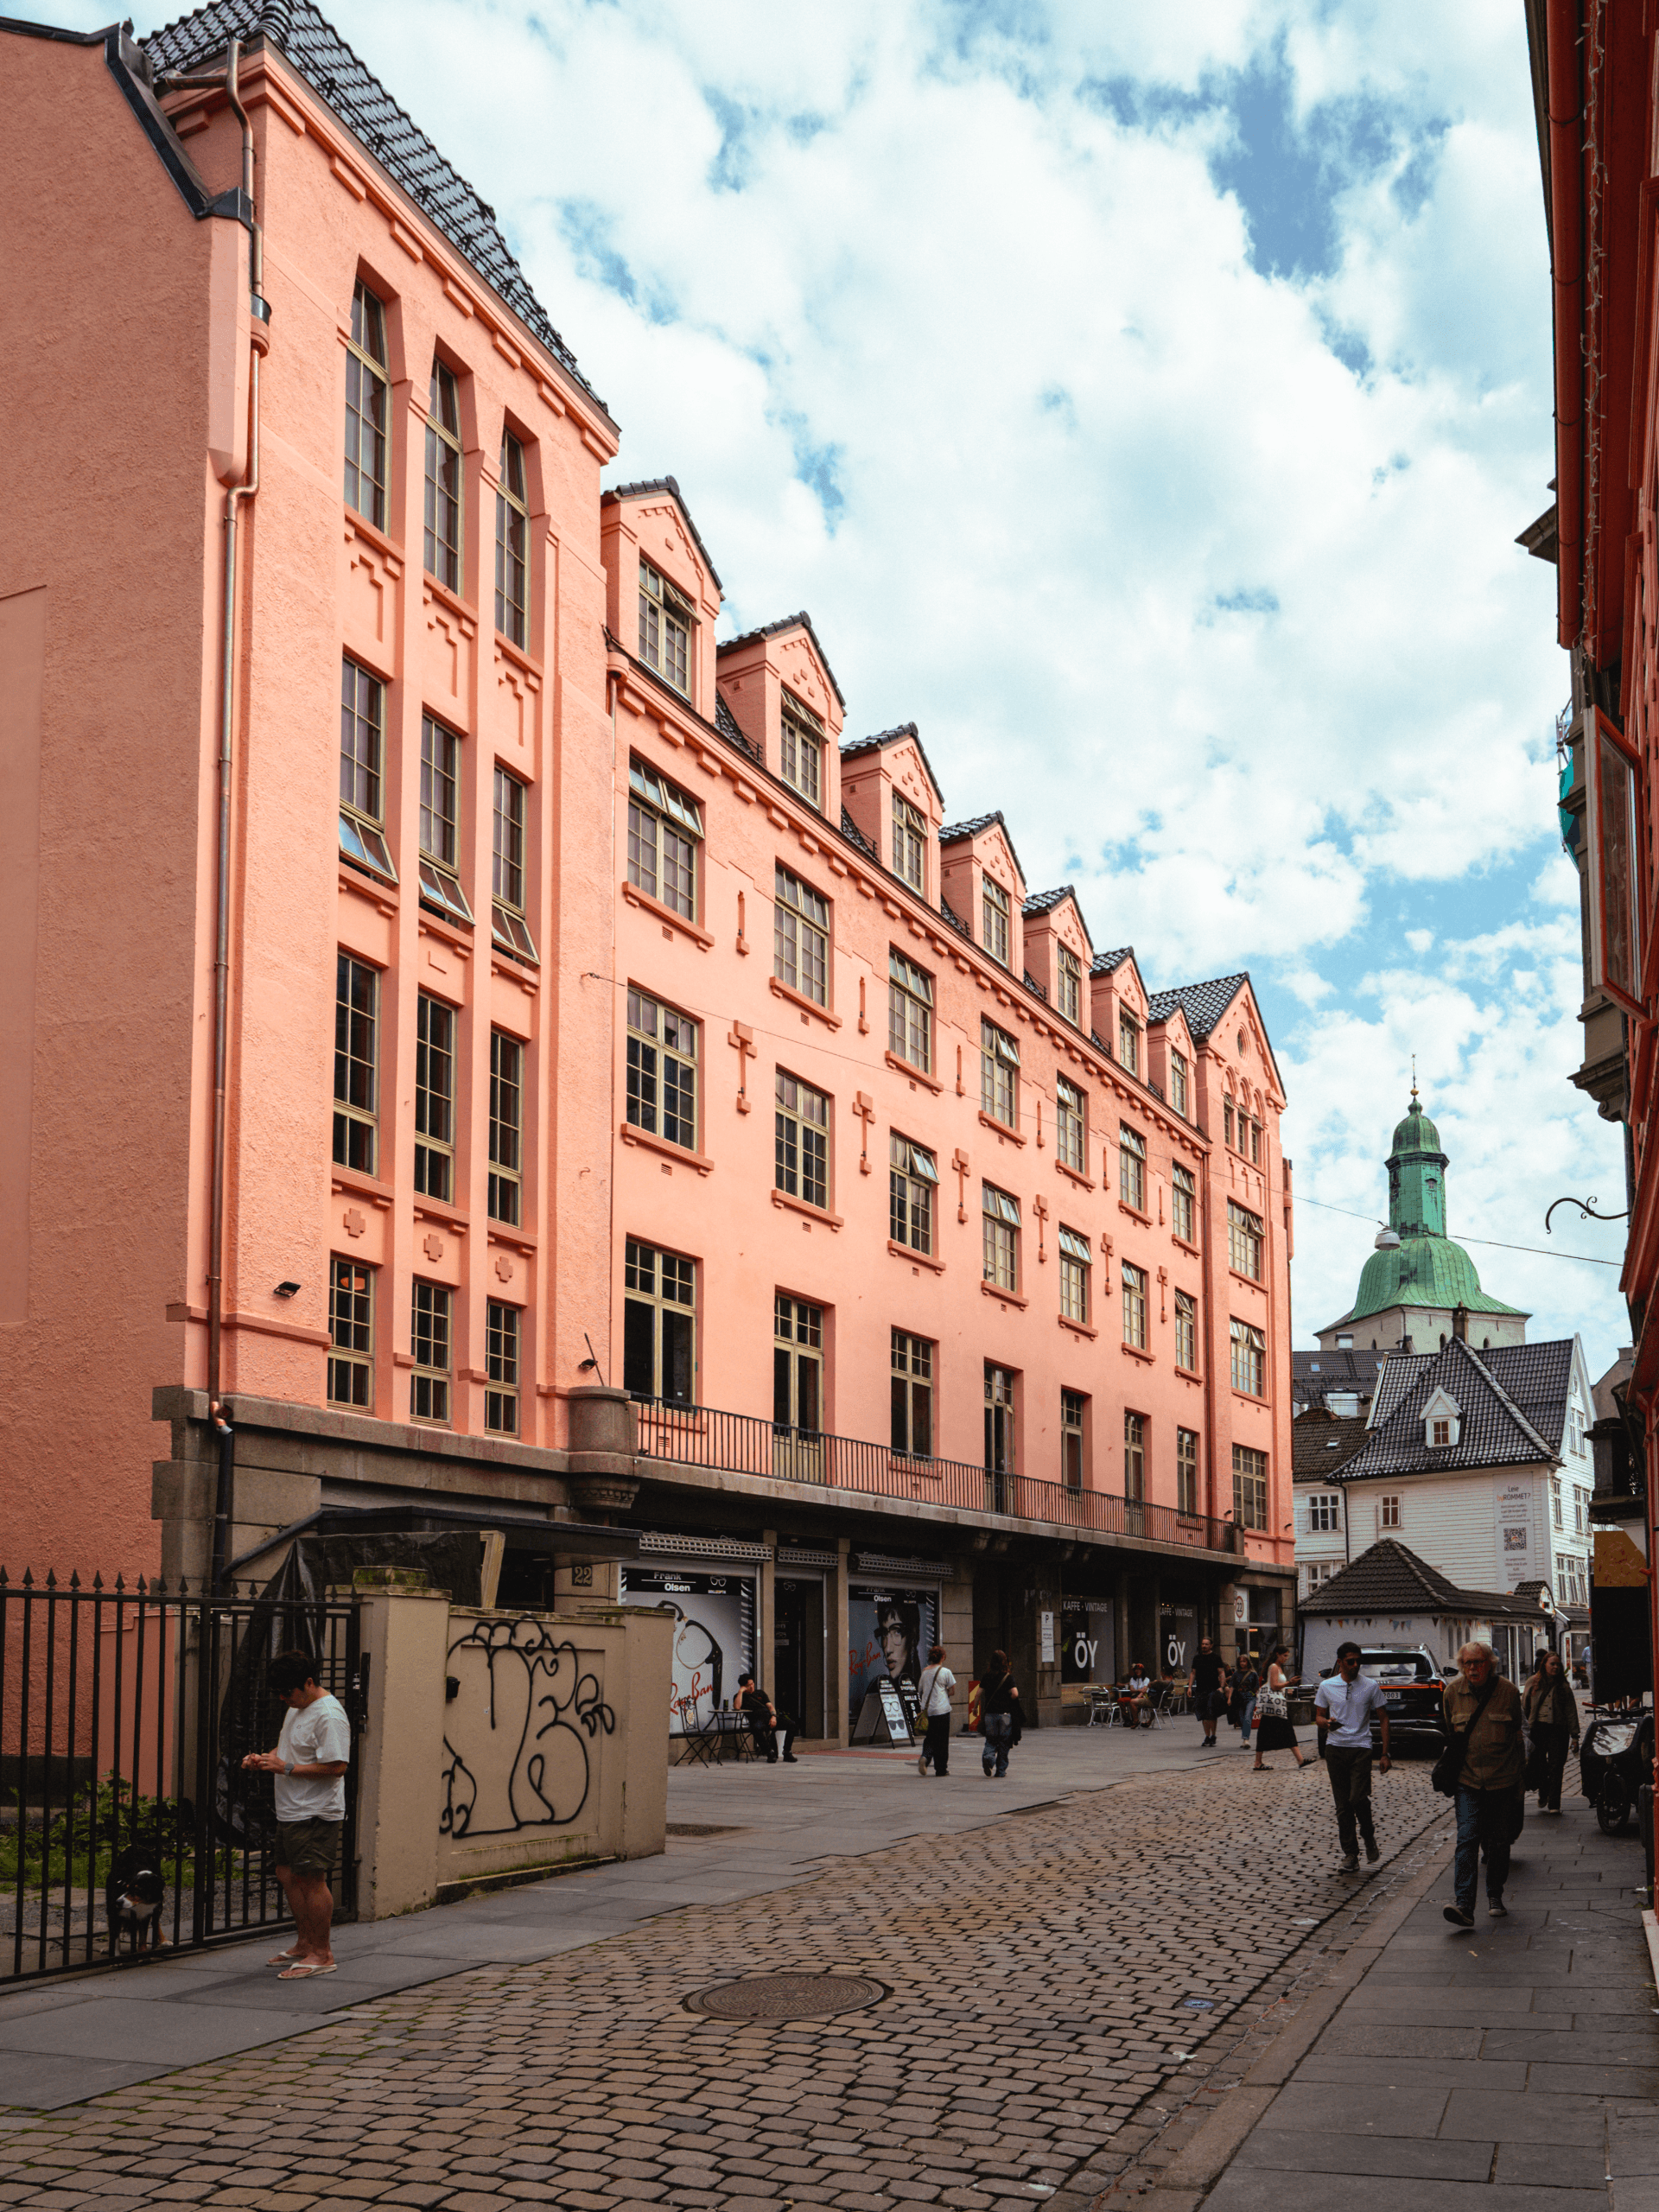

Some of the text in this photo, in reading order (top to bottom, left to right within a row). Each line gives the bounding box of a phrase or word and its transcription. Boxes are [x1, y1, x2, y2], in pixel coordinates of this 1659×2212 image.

[575, 1566, 592, 1584] 22
[664, 1583, 690, 1592] Olsen
[1063, 1600, 1108, 1612] KAFFE VINTAGE
[1236, 1602, 1243, 1612] 22
[1175, 1608, 1193, 1618] VINTAGE
[849, 1642, 880, 1676] Ray-Ban
